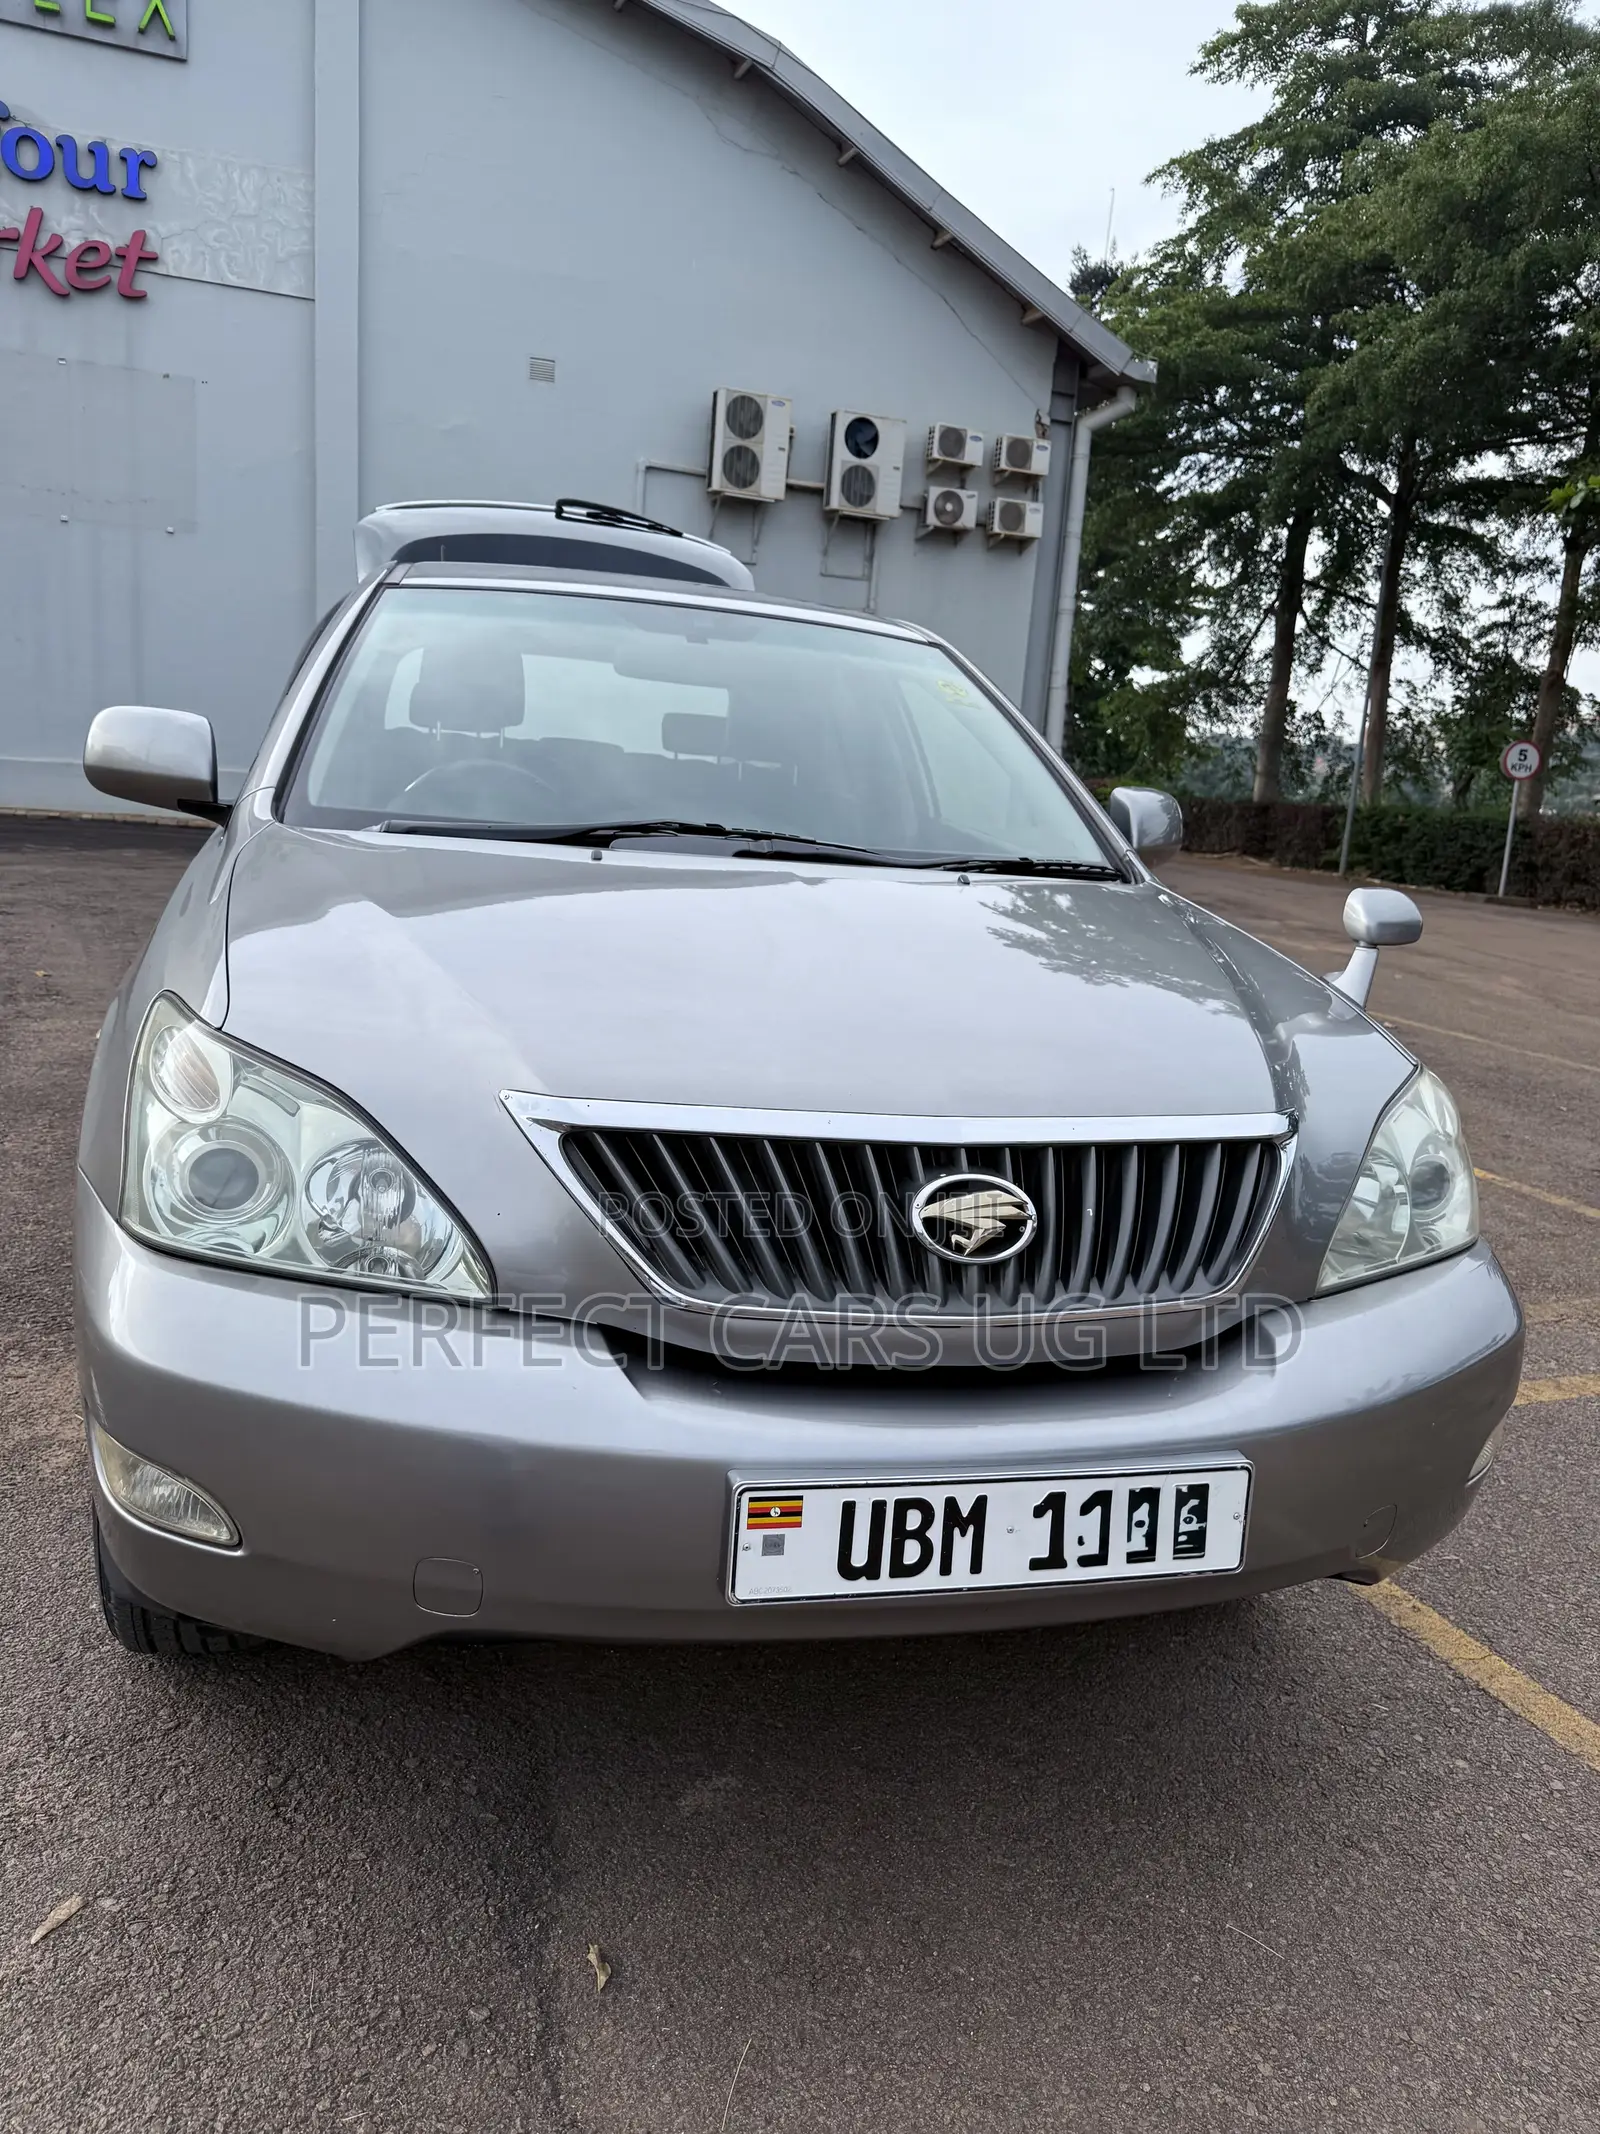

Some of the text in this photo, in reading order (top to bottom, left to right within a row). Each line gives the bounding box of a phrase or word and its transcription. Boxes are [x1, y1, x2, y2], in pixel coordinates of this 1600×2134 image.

[0, 102, 158, 200] our
[1510, 763, 1533, 773] KPH
[1518, 749, 1528, 762] 5
[837, 1494, 988, 1580] UBM
